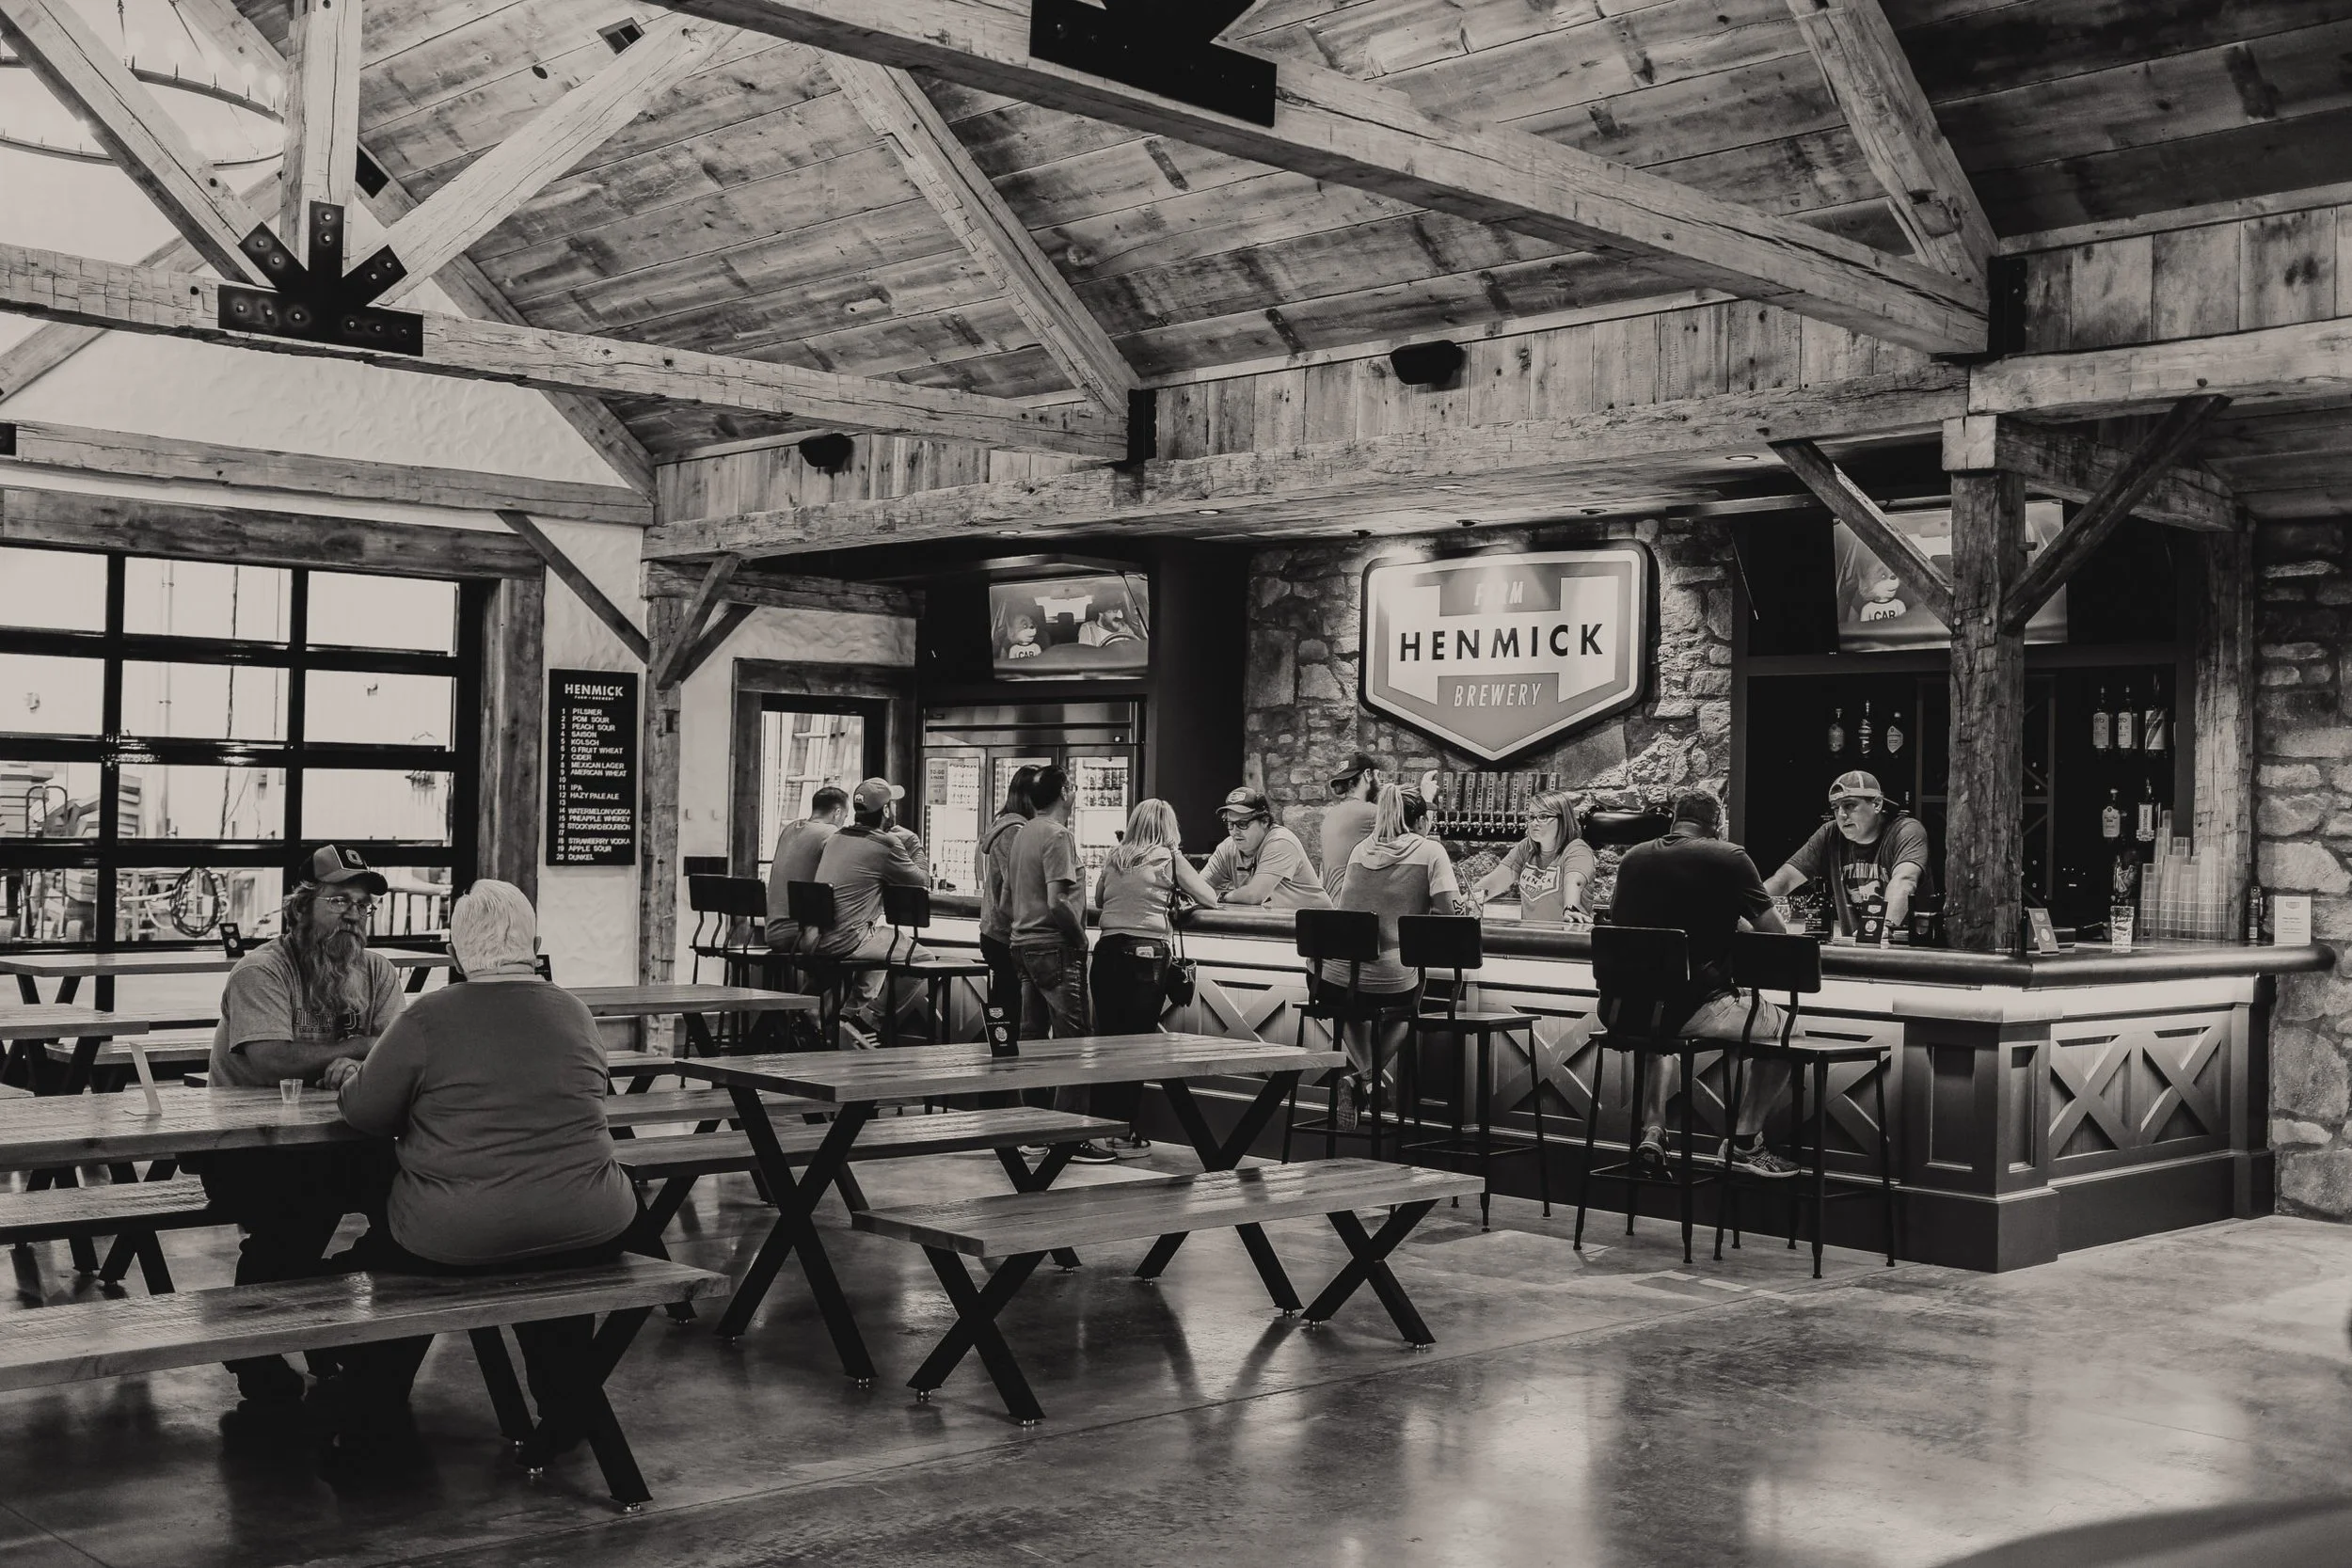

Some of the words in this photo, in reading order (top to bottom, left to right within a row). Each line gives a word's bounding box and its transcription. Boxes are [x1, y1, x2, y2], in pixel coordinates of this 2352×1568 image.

[1473, 580, 1524, 606] FRM
[1400, 623, 1603, 662] HENMICK
[564, 683, 624, 697] HENMICK
[1454, 682, 1542, 707] BREWERY
